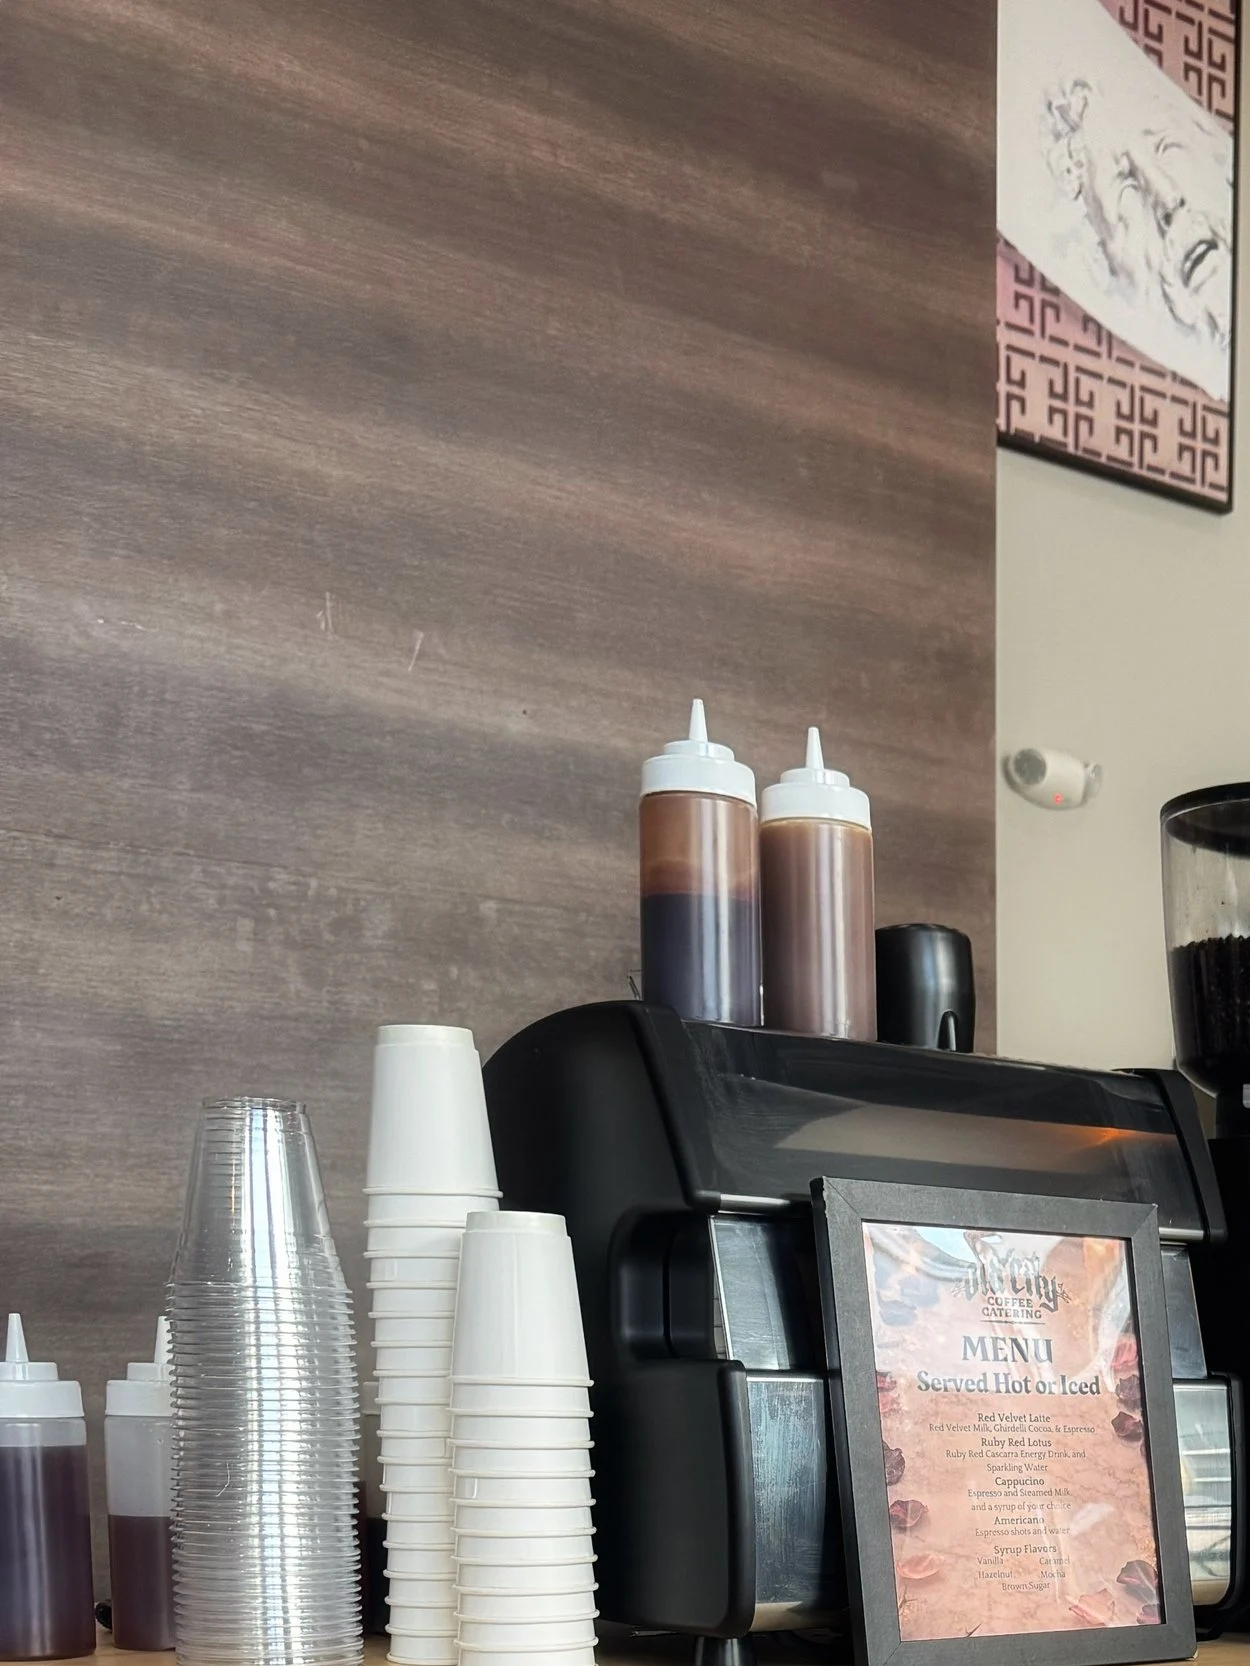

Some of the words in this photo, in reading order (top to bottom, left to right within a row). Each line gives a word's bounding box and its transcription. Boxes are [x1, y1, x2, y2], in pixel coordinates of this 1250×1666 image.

[987, 1296, 1033, 1308] COFFEE
[982, 1307, 1042, 1319] CATERING
[962, 1335, 1053, 1364] MENU
[917, 1371, 988, 1393] Served
[993, 1372, 1031, 1394] Hot
[1035, 1378, 1057, 1394] or
[1060, 1374, 1101, 1396] Iced
[978, 1413, 995, 1422] Red
[998, 1413, 1027, 1422] Velvet
[1029, 1414, 1051, 1423] Latte
[929, 1424, 944, 1432] Red
[947, 1424, 971, 1433] Velvet
[1063, 1425, 1096, 1435] Espresso
[981, 1438, 1006, 1449] Ruby
[1008, 1438, 1026, 1447] Red
[1028, 1438, 1052, 1447] Lotus
[946, 1450, 966, 1459] Ruby
[968, 1450, 983, 1458] Red
[985, 1450, 1019, 1458] Cascarra
[1020, 1450, 1047, 1460] Energy
[1072, 1450, 1086, 1458] and
[986, 1463, 1023, 1474] Sparkling
[1024, 1463, 1048, 1472] Water
[995, 1477, 1045, 1489] Cappucino
[968, 1489, 1002, 1499] Espresso
[1003, 1489, 1018, 1497] and
[1019, 1489, 1053, 1497] Steamed
[971, 1502, 986, 1511] and
[994, 1504, 1015, 1514] syrup
[1017, 1502, 1027, 1511] of
[993, 1516, 1045, 1526] Americano
[975, 1528, 1009, 1539] Espresso
[1010, 1527, 1032, 1536] shots
[1032, 1526, 1047, 1535] and
[993, 1545, 1021, 1556] Syrup
[1024, 1544, 1057, 1553] Flavors
[977, 1557, 1004, 1565] Vanilla
[978, 1571, 1013, 1579] Hazelnut
[1040, 1571, 1066, 1579] Mocha
[1002, 1583, 1028, 1591] Brown
[1028, 1582, 1050, 1591] Sugar
